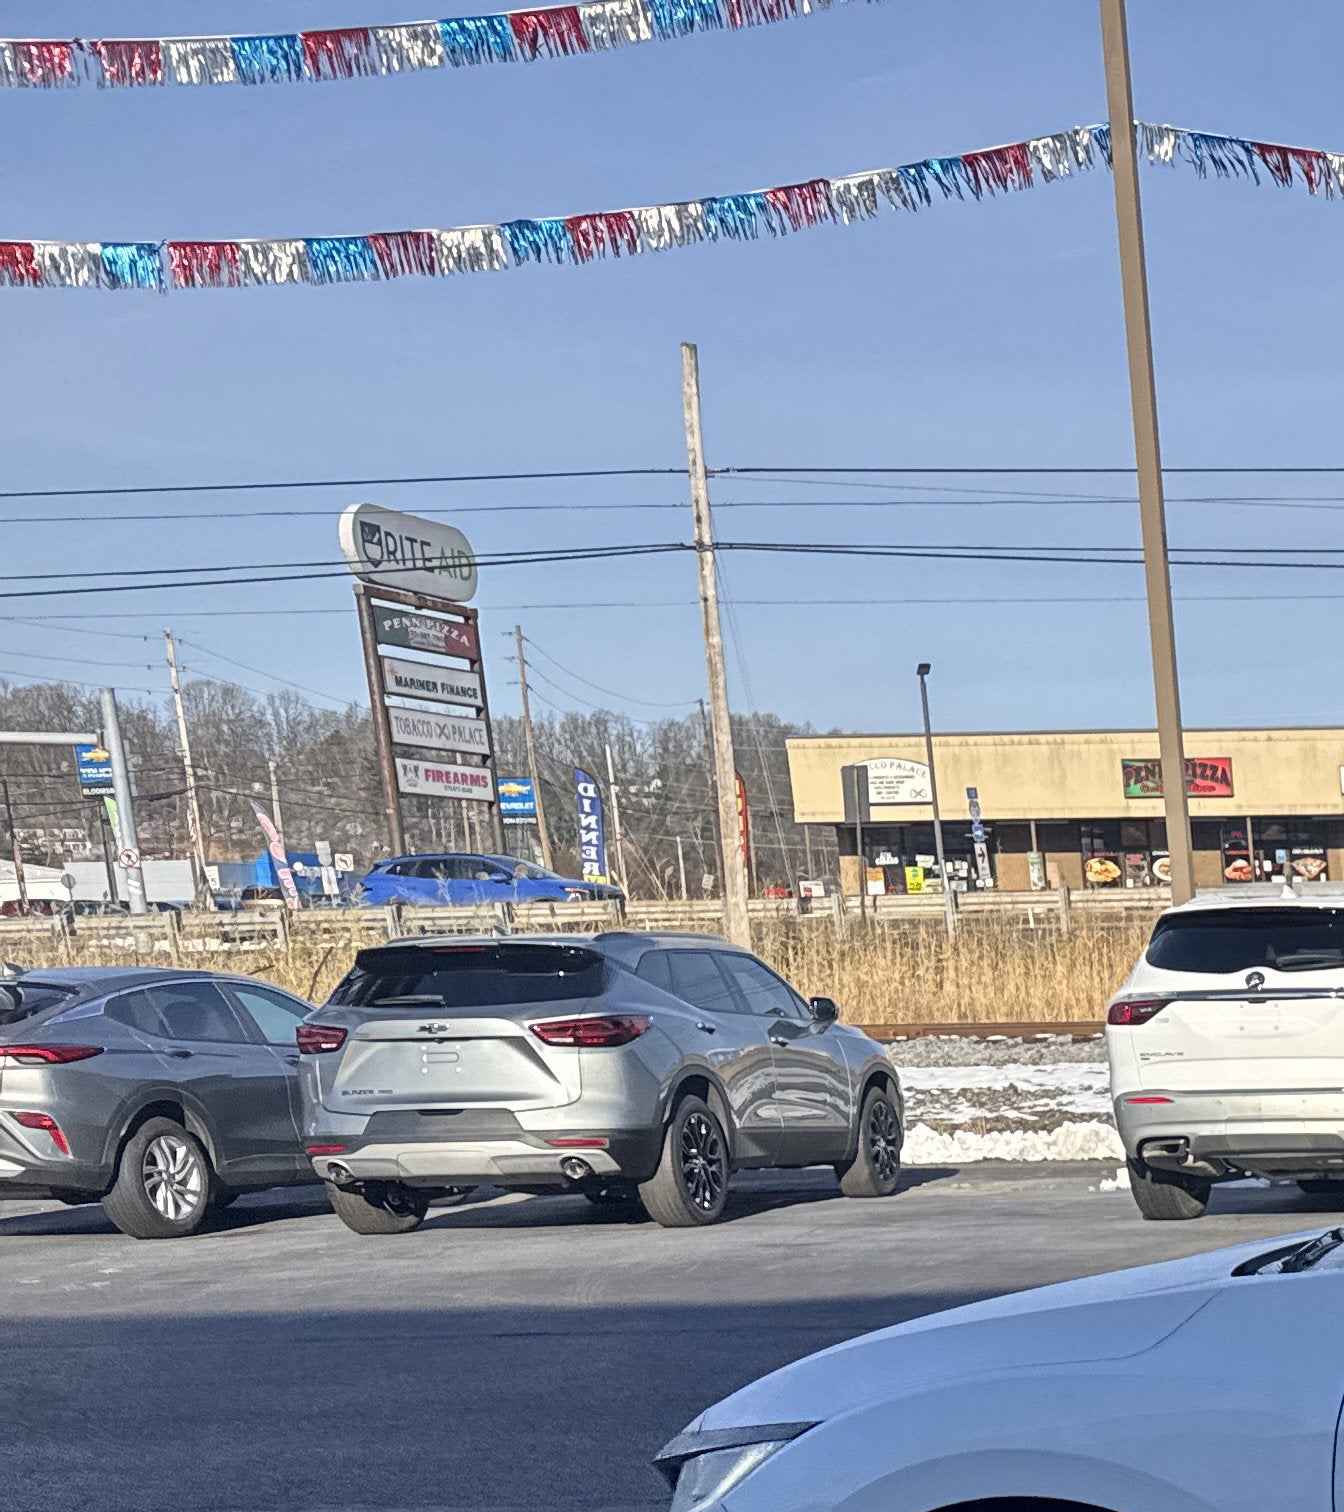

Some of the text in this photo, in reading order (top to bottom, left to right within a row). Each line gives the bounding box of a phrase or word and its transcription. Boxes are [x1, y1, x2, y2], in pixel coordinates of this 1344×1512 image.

[384, 531, 472, 581] RITE AID
[383, 617, 421, 631] PENN
[425, 619, 470, 648] PIZZA
[395, 675, 479, 700] MARINER FINANCE
[394, 716, 485, 746] TOBACCO PALACE
[424, 768, 488, 788] FIREARMS
[1123, 763, 1163, 787] PEN
